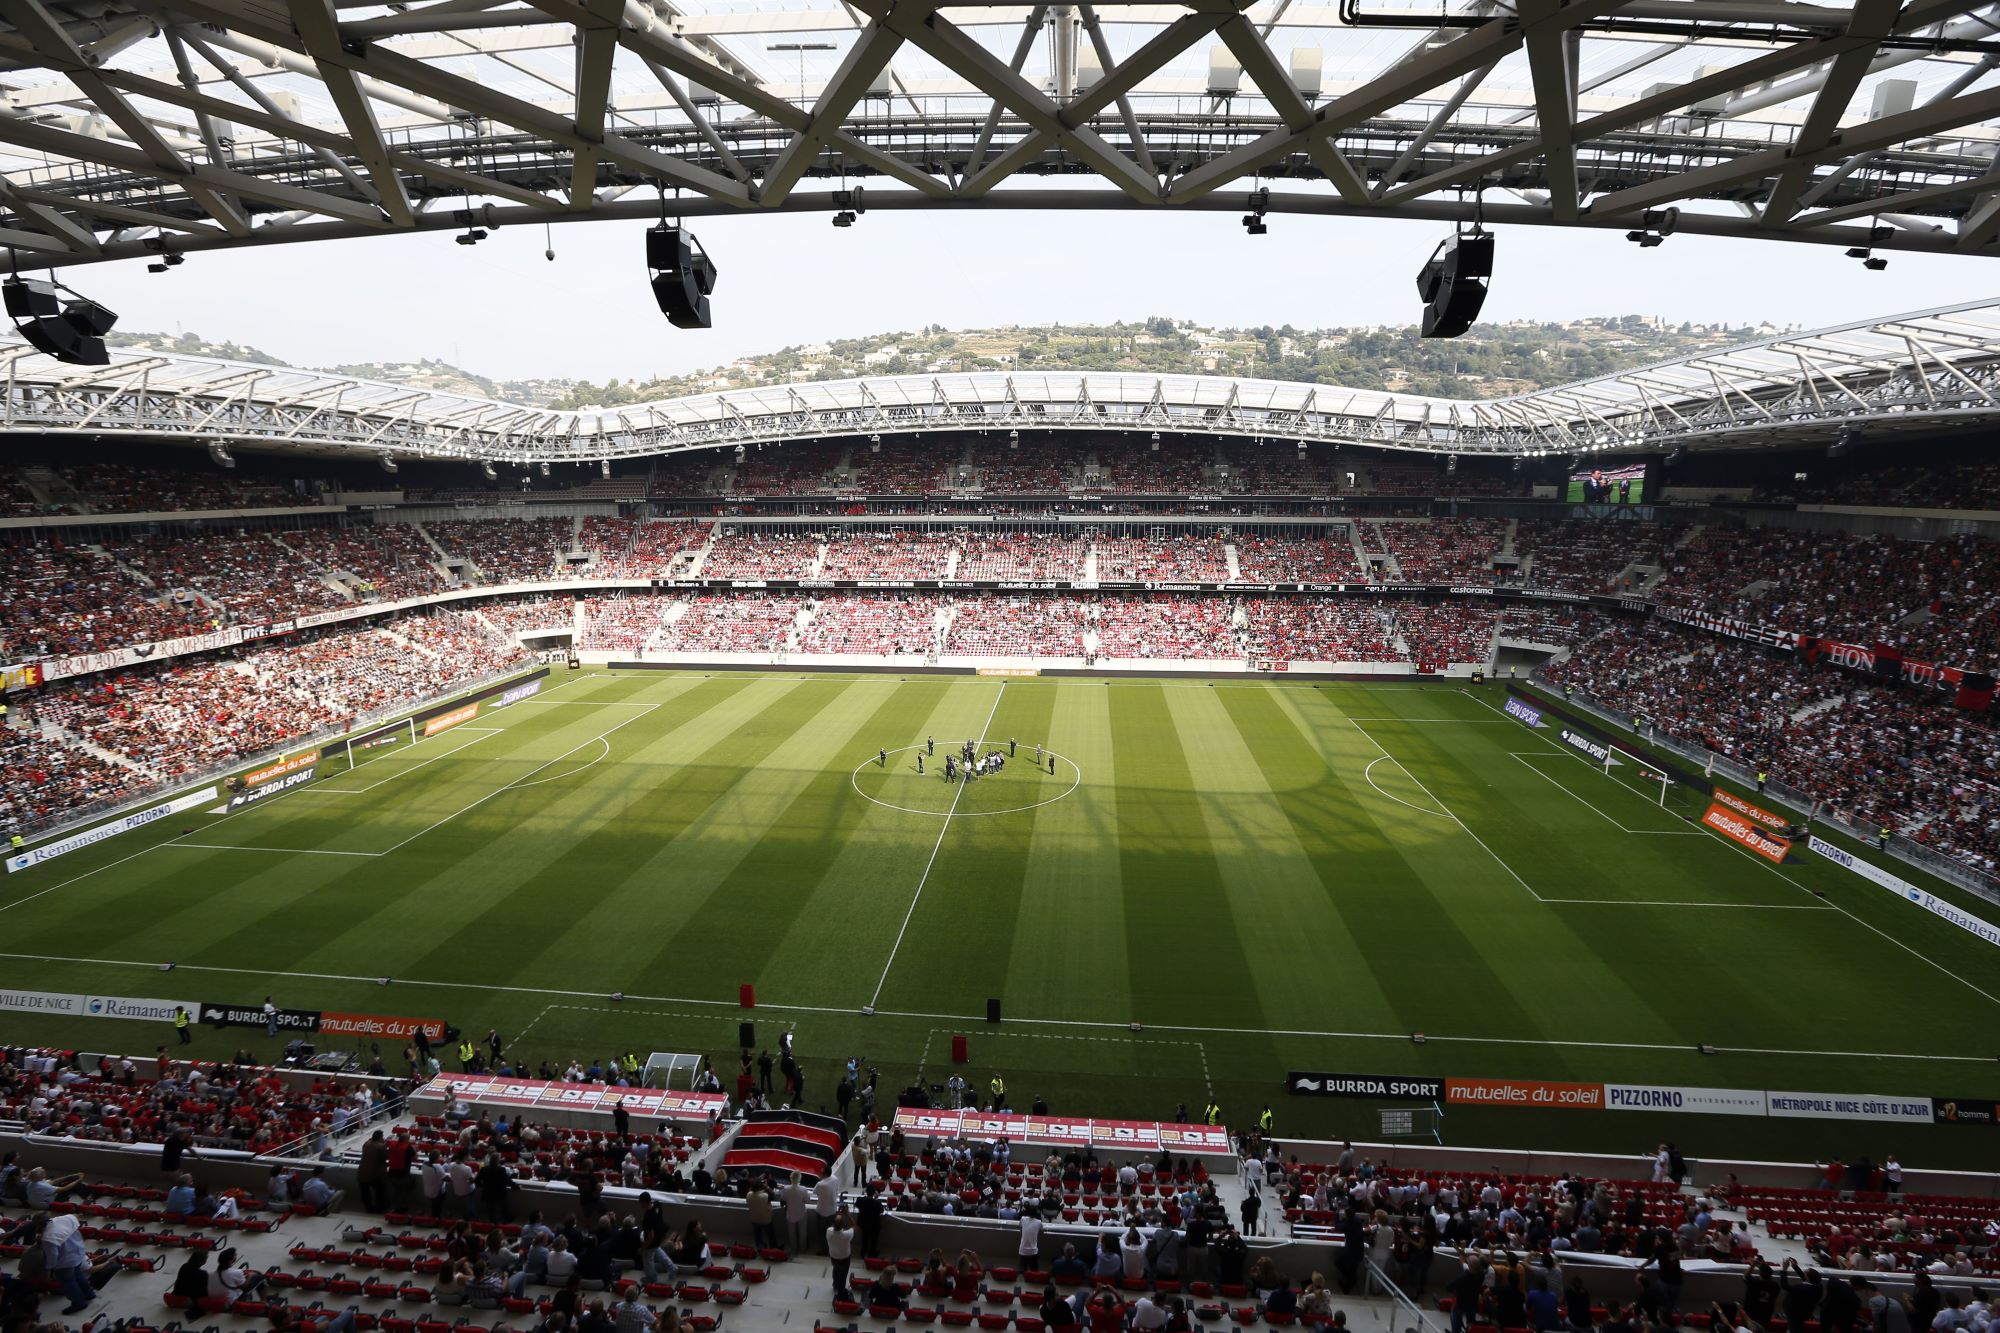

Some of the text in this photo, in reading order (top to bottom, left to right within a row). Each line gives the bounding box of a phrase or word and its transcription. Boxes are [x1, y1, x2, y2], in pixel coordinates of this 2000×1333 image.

[1154, 582, 1200, 590] Rémanence
[1450, 586, 1494, 594] castorama
[1519, 708, 1540, 726] SPORT
[1567, 733, 1608, 760] BURRDA SPORT
[248, 752, 318, 784] mutuelles du soleil
[285, 768, 314, 788] SPORT
[1714, 792, 1748, 813] mutuelles
[1750, 808, 1762, 820] du
[33, 824, 120, 863] Rémanence
[126, 804, 172, 829] PIZZORNO
[1707, 812, 1749, 838] mutuelles
[1811, 838, 1854, 868] PIZZORNO
[1924, 894, 2000, 946] Rémanen
[26, 996, 44, 1008] DE
[46, 998, 72, 1010] NICE
[320, 1018, 384, 1034] mutuelles
[386, 1020, 404, 1034] du
[1326, 1079, 1439, 1096] BURRDA SPORT
[1450, 1085, 1600, 1104] mutuelles du soleil
[1610, 1088, 1683, 1108] PIZZORNO
[1772, 1096, 1929, 1116] MÉTROPOLE NICE CÔTE D'AZUR
[1938, 1108, 1946, 1118] le
[1958, 1110, 1990, 1120] homme
